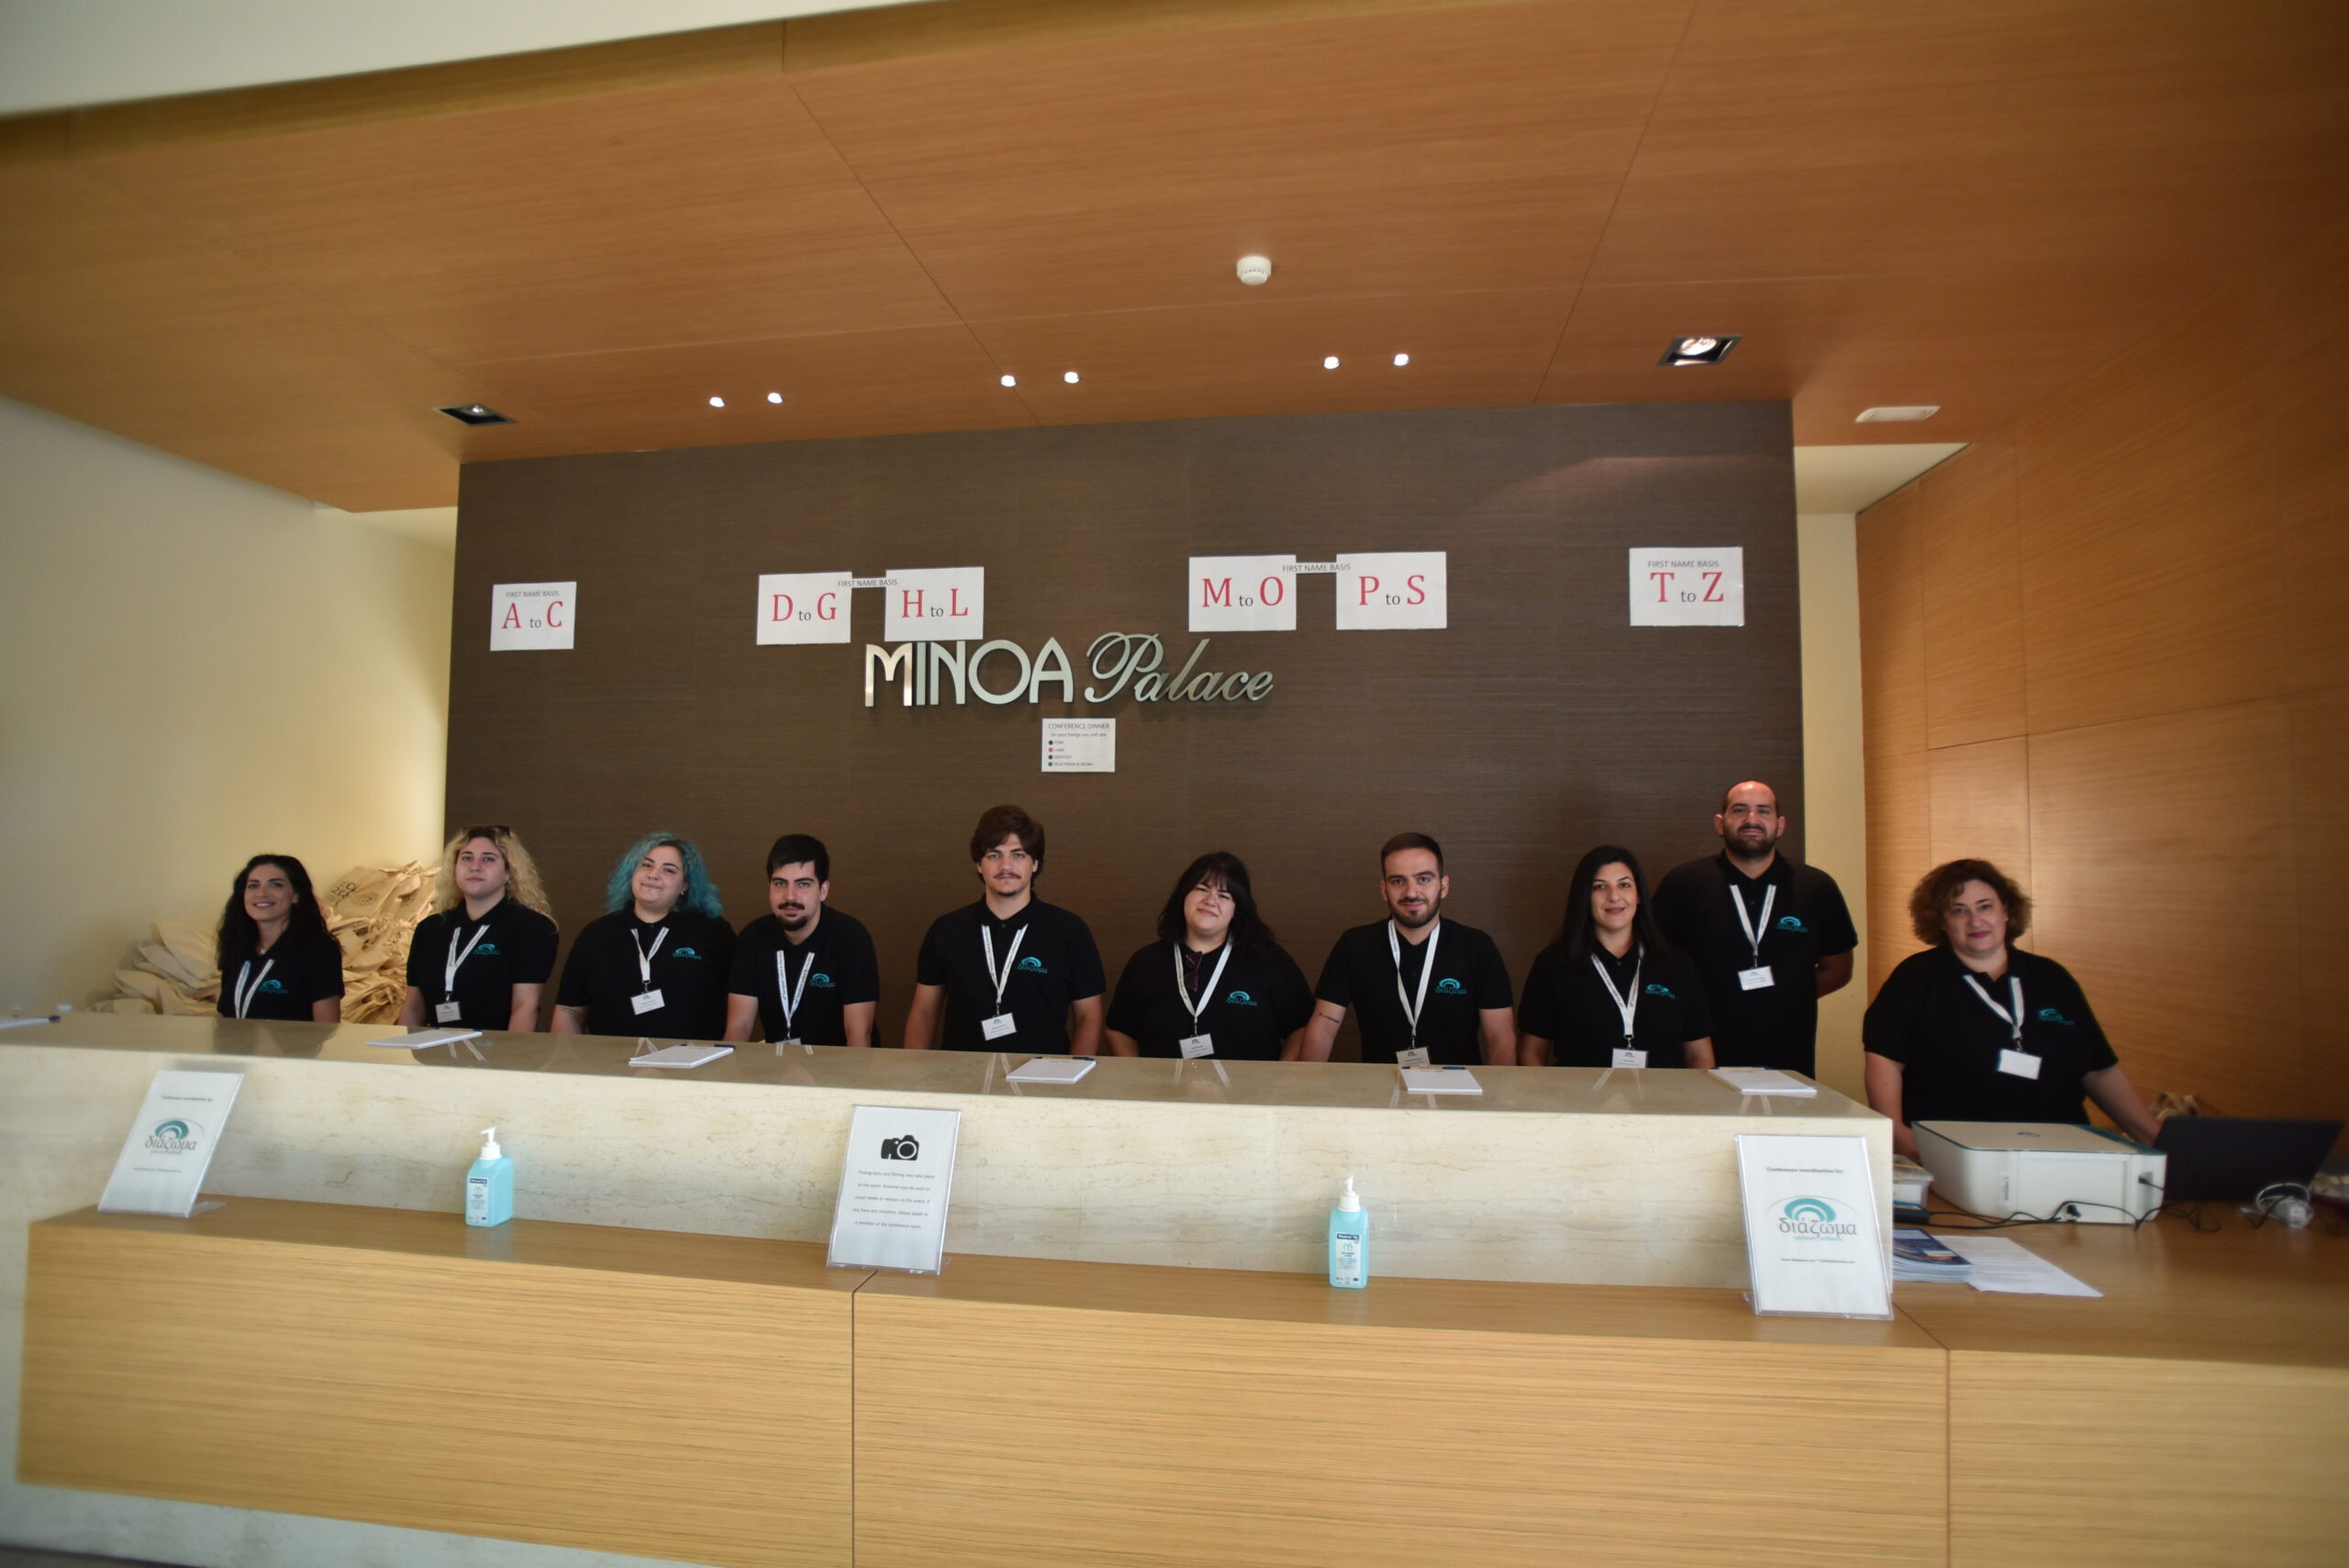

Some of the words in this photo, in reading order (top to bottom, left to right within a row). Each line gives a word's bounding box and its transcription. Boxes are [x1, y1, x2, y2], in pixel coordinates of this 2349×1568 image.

[1283, 564, 1302, 573] FIRST
[1330, 563, 1351, 572] BASIS
[1698, 560, 1720, 568] BASIS
[857, 579, 878, 587] NAME
[879, 578, 897, 586] BASIS
[1202, 578, 1232, 607] M
[1239, 595, 1253, 606] to
[1260, 576, 1284, 606] O
[1358, 576, 1380, 606] P
[1386, 594, 1400, 606] to
[1407, 574, 1425, 606] S
[1650, 572, 1675, 602] T
[1680, 590, 1696, 602] to
[1702, 572, 1724, 602] Z
[501, 602, 521, 629] A
[529, 618, 541, 628] to
[547, 601, 563, 628] C
[772, 594, 793, 622] D
[798, 609, 811, 621] to
[817, 592, 838, 621] G
[901, 589, 924, 618] H
[930, 606, 944, 617] to
[950, 588, 969, 617] L
[864, 637, 1074, 707] MINOA
[1085, 631, 1275, 703] Palace
[1779, 1218, 1857, 1239] διάζωμα
